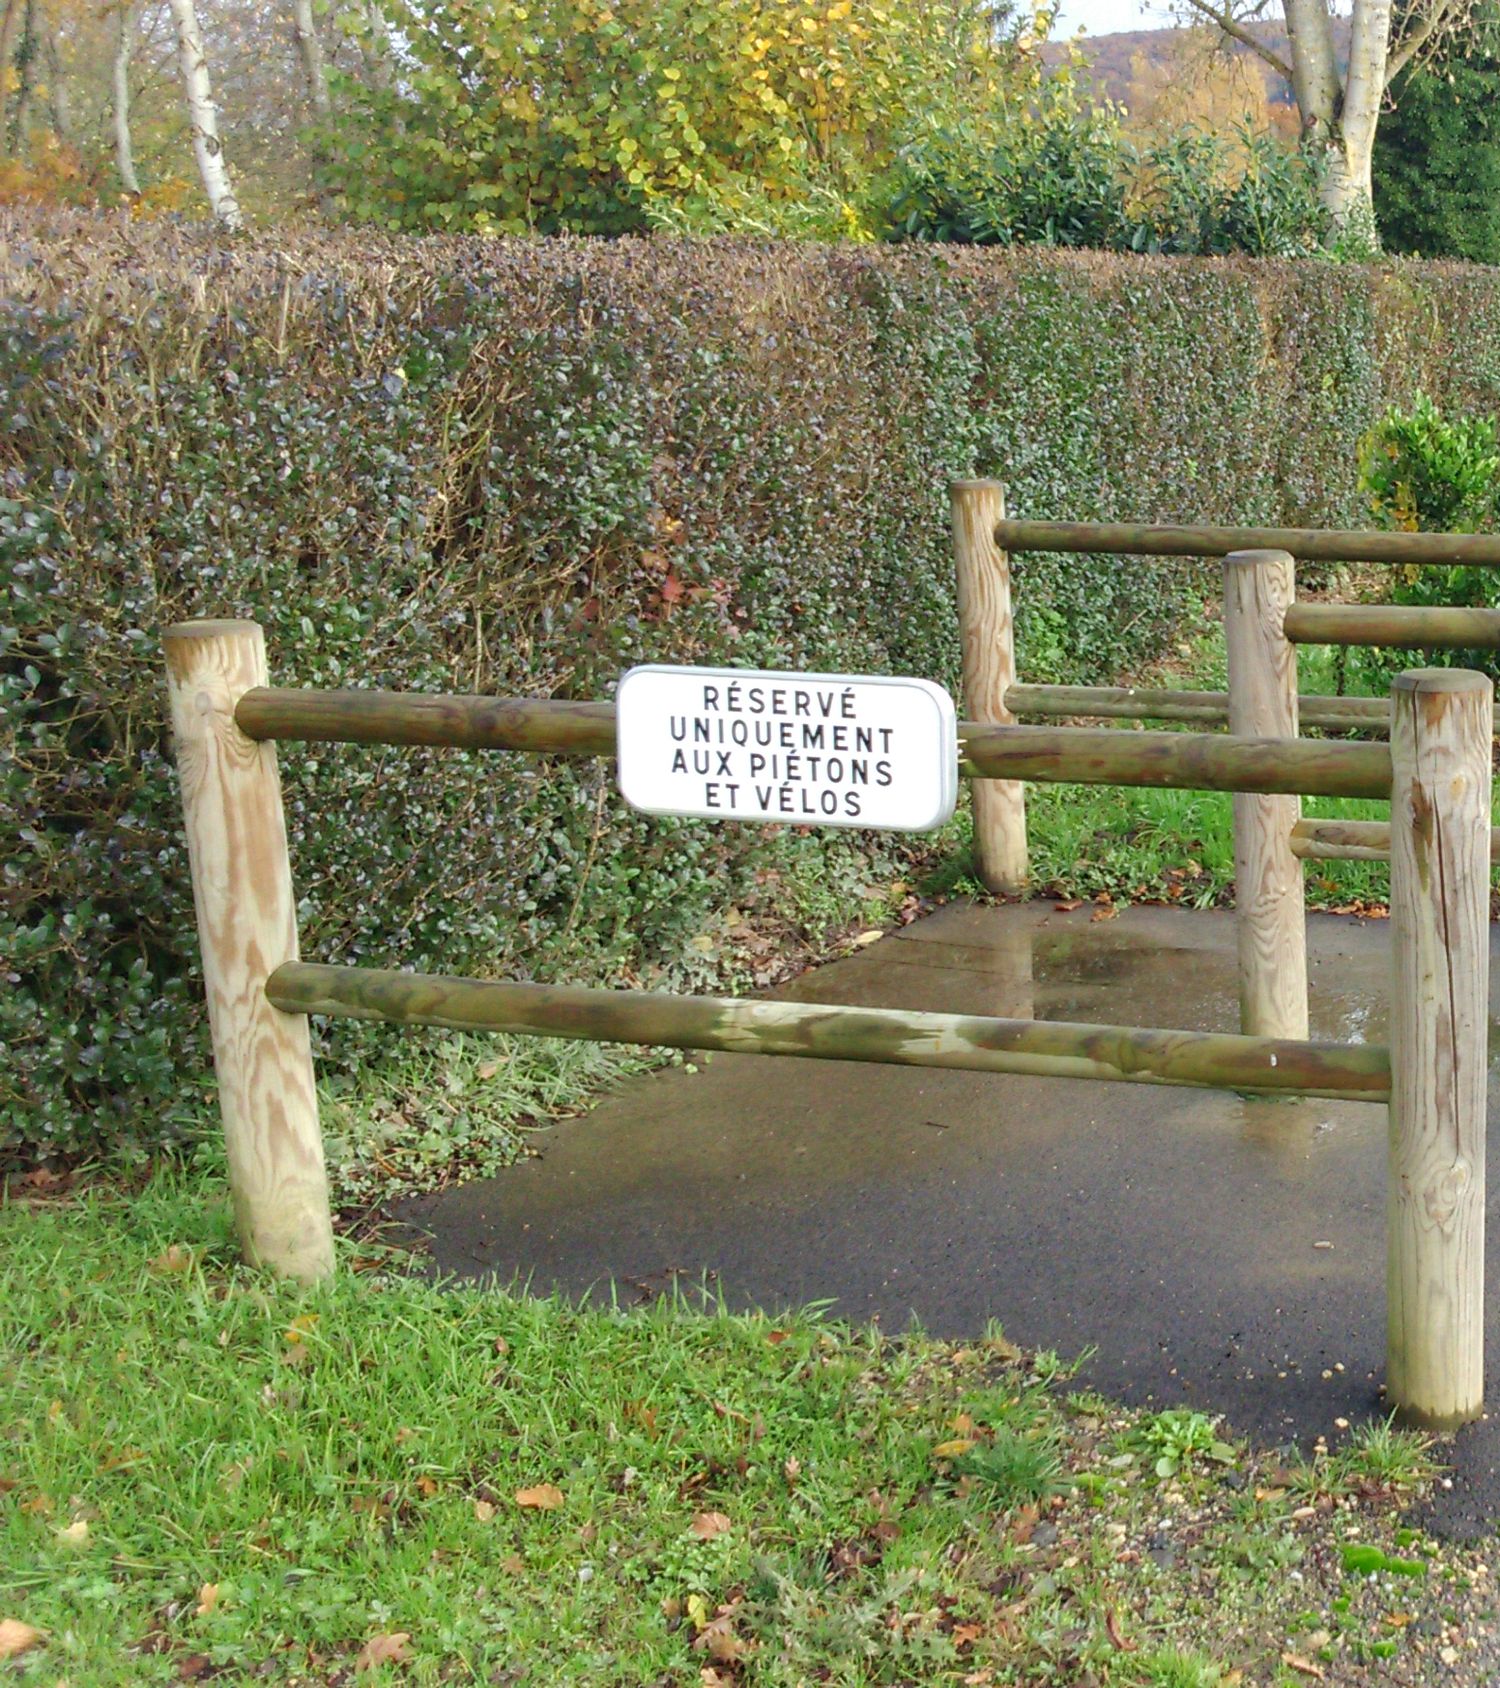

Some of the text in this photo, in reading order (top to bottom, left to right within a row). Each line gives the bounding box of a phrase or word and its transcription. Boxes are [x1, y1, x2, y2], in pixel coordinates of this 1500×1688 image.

[703, 680, 857, 719] RÉSERVÉ
[670, 716, 894, 754] UNIQUEMENT
[672, 748, 893, 787] AUX PIÉTONS
[706, 781, 862, 817] ET VÉLOS
